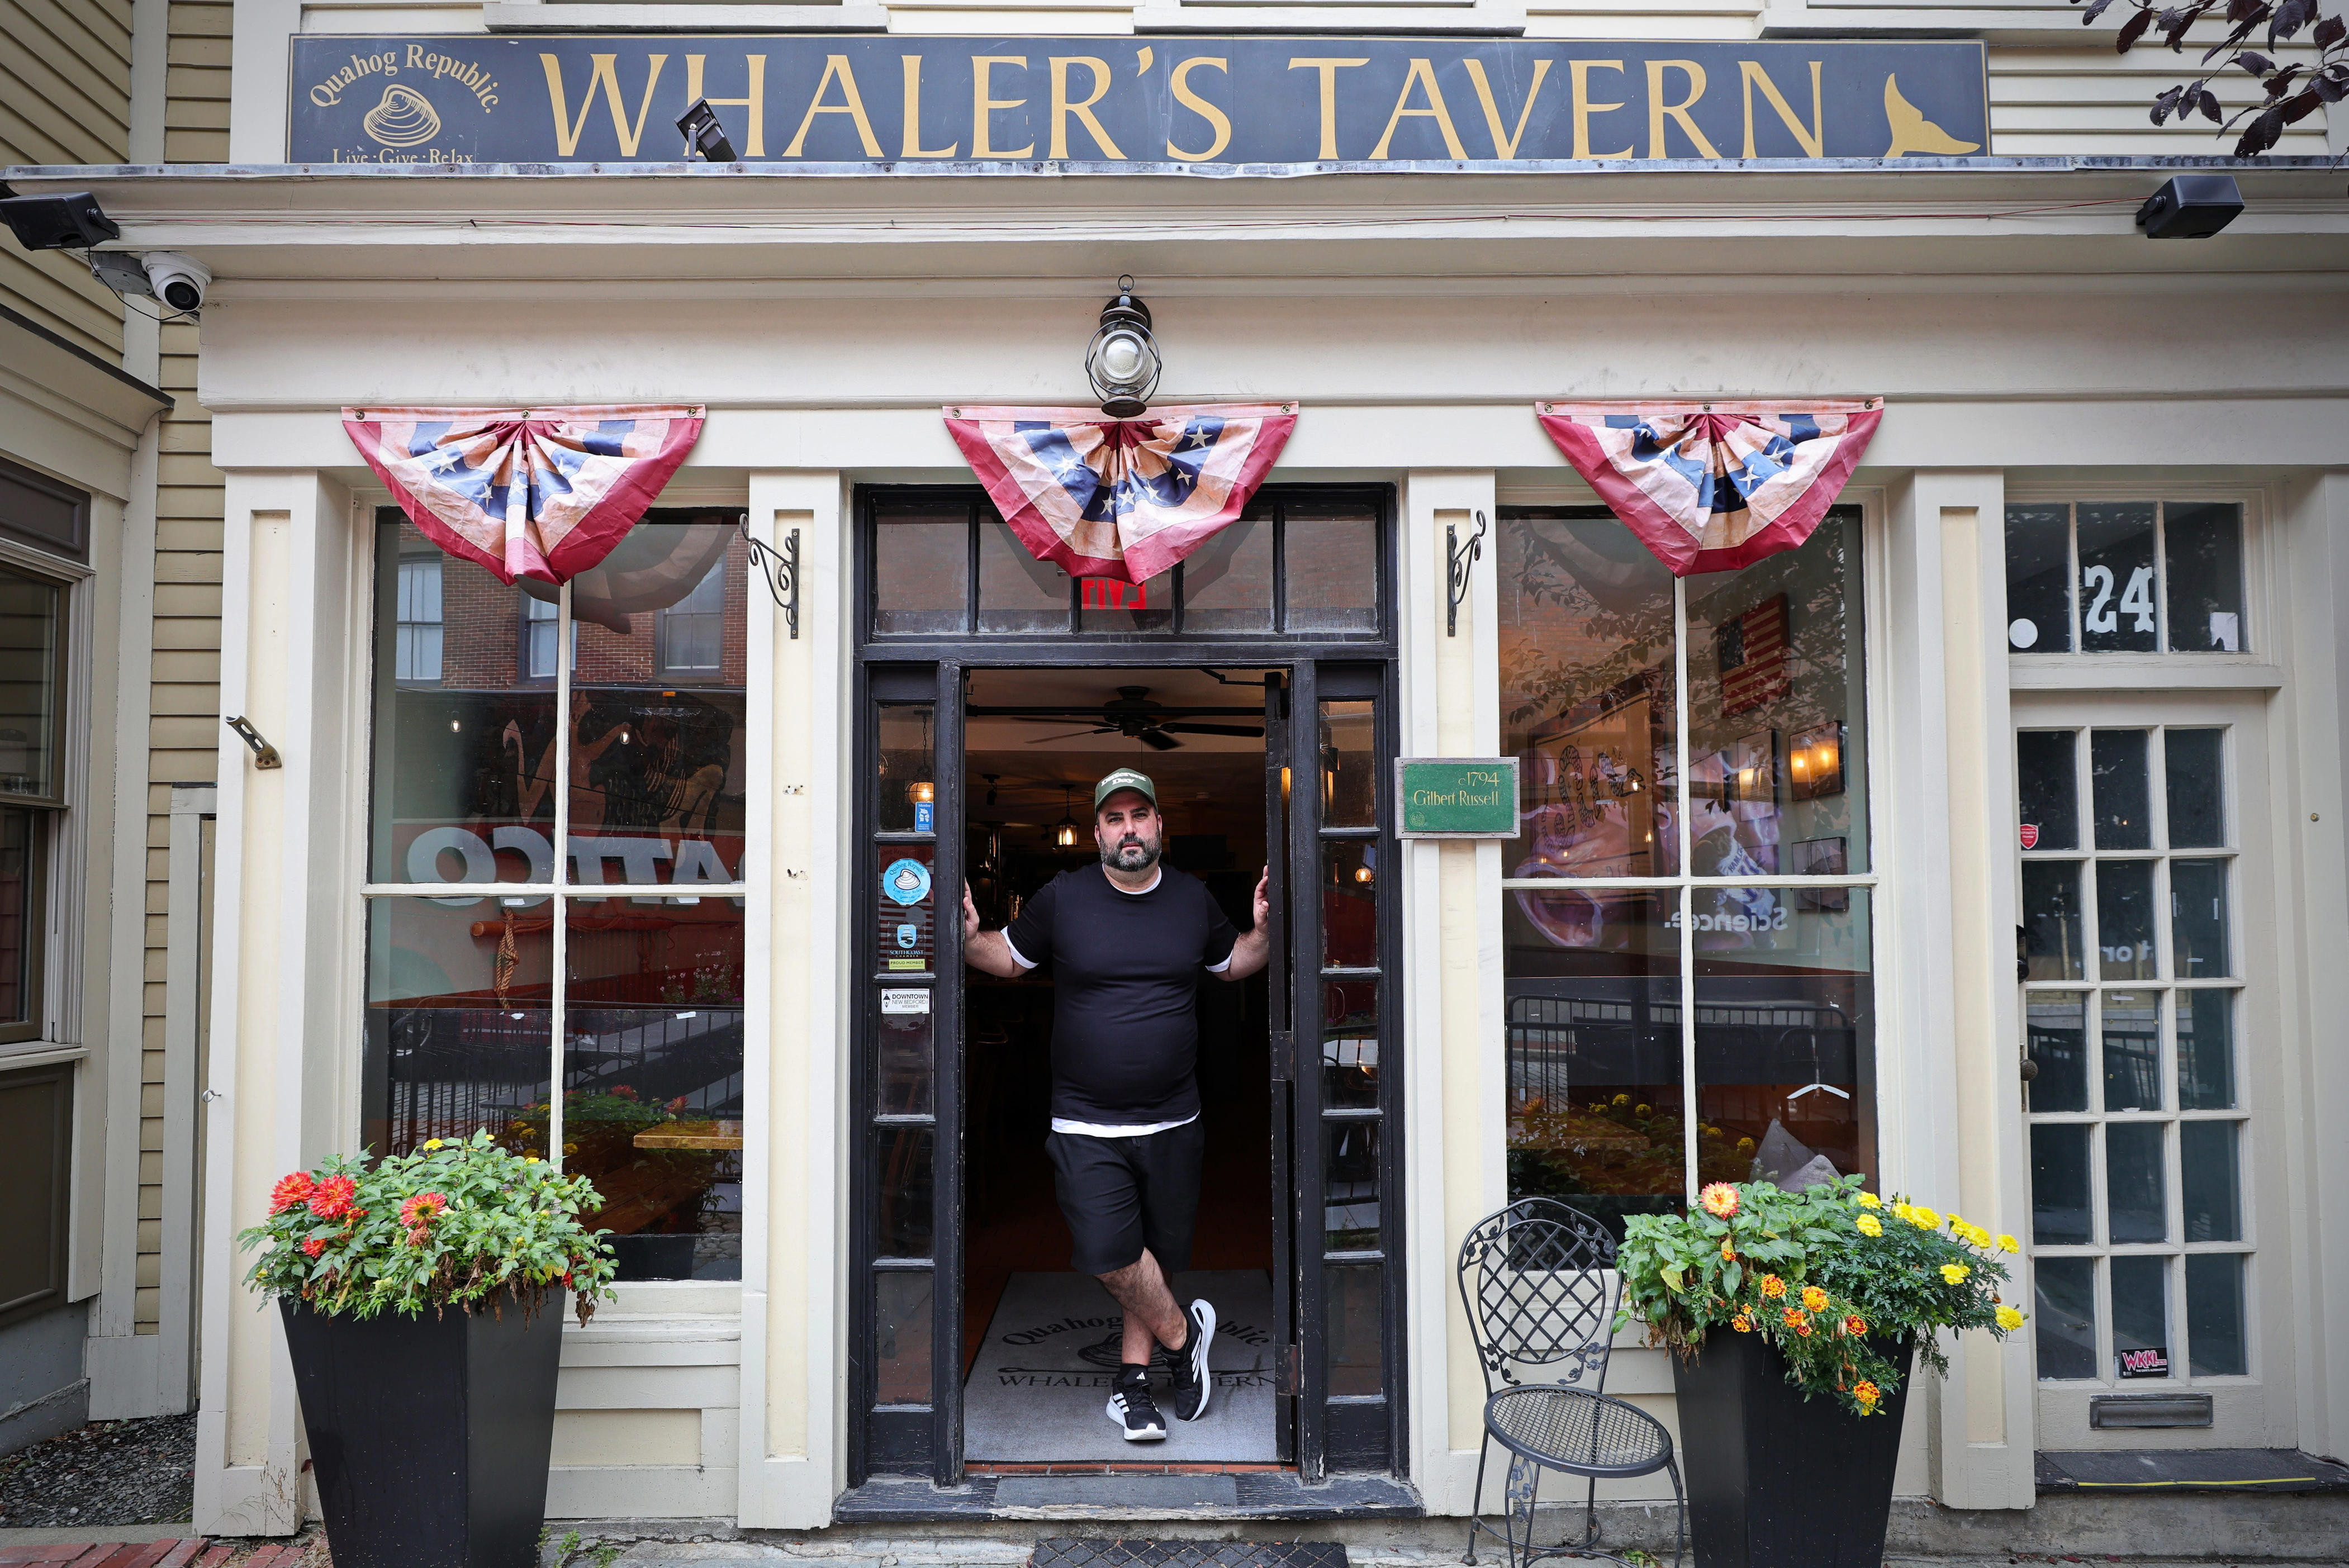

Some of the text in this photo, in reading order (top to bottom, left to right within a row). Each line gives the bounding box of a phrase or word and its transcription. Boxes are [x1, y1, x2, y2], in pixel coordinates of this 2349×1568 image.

[310, 51, 398, 107] Quahog
[538, 45, 1823, 161] WHALER'S TAVERN
[333, 148, 474, 163] Live Give Relax
[2084, 564, 2156, 634] 24
[1413, 790, 1499, 806] Gilbert Russell
[889, 861, 926, 877] Quahog Republic
[1002, 1316, 1123, 1346] Quahog
[2122, 1350, 2167, 1371] WKKL
